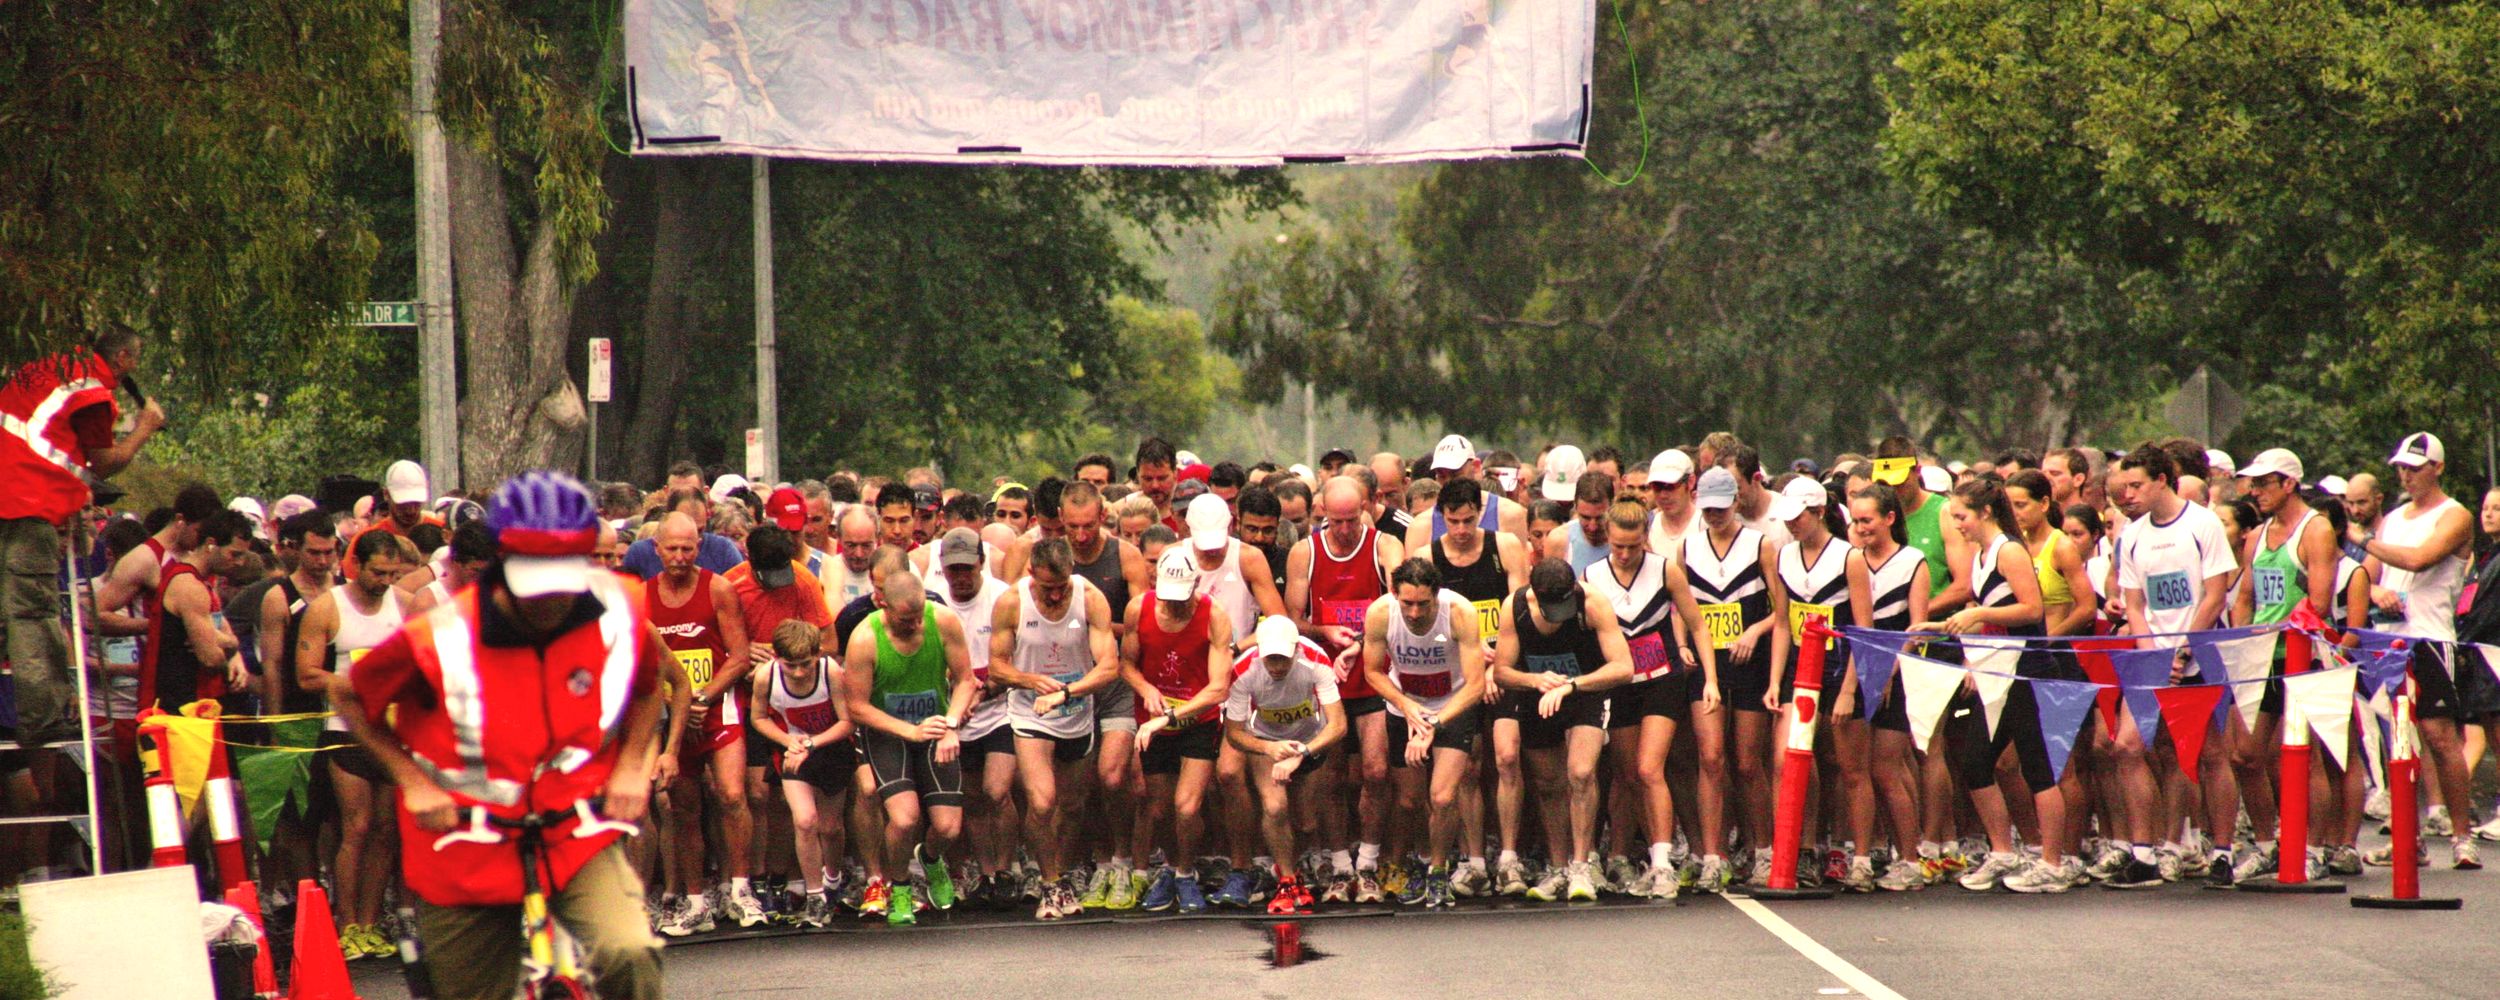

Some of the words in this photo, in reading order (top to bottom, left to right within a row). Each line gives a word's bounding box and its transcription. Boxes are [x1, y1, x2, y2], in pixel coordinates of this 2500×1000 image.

[374, 305, 392, 322] DR
[2156, 577, 2191, 606] 4368
[2263, 575, 2284, 601] 975
[657, 622, 696, 634] aucony
[1477, 606, 1499, 632] 70
[1705, 611, 1740, 637] 2738
[1396, 645, 1445, 657] LOVE
[1398, 656, 1419, 665] the
[1423, 657, 1446, 665] run
[1632, 640, 1666, 671] 686
[682, 658, 711, 683] 780
[896, 697, 936, 718] 4409
